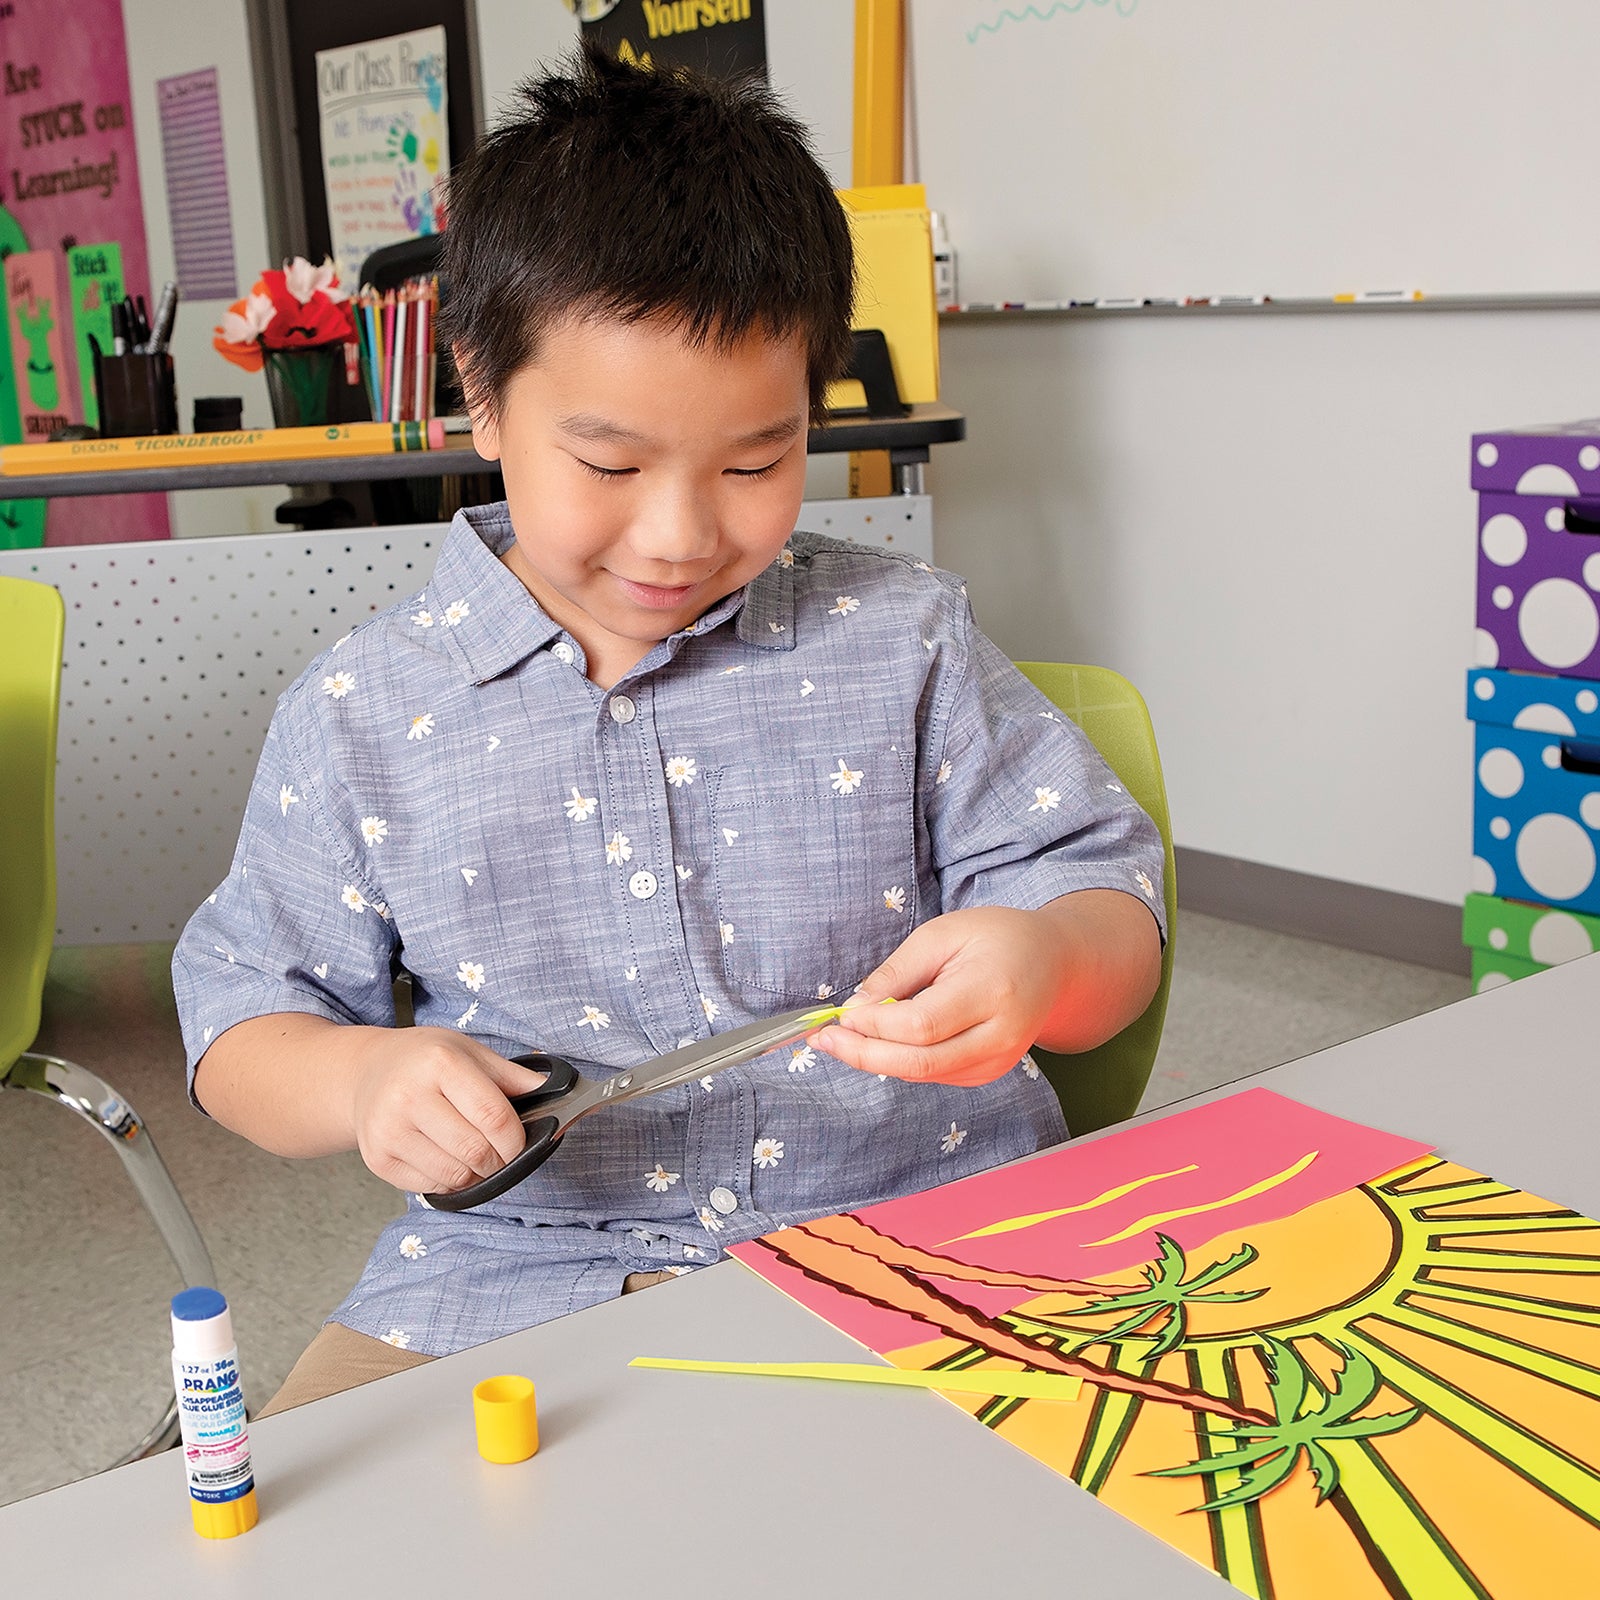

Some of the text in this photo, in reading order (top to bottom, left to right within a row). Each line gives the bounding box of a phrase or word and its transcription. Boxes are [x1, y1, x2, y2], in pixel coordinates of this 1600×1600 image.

[4, 62, 41, 96] Are
[20, 102, 125, 148] STUCK on
[72, 443, 119, 455] DIXON
[183, 1369, 238, 1391] PRANG
[201, 1402, 224, 1413] GLUE
